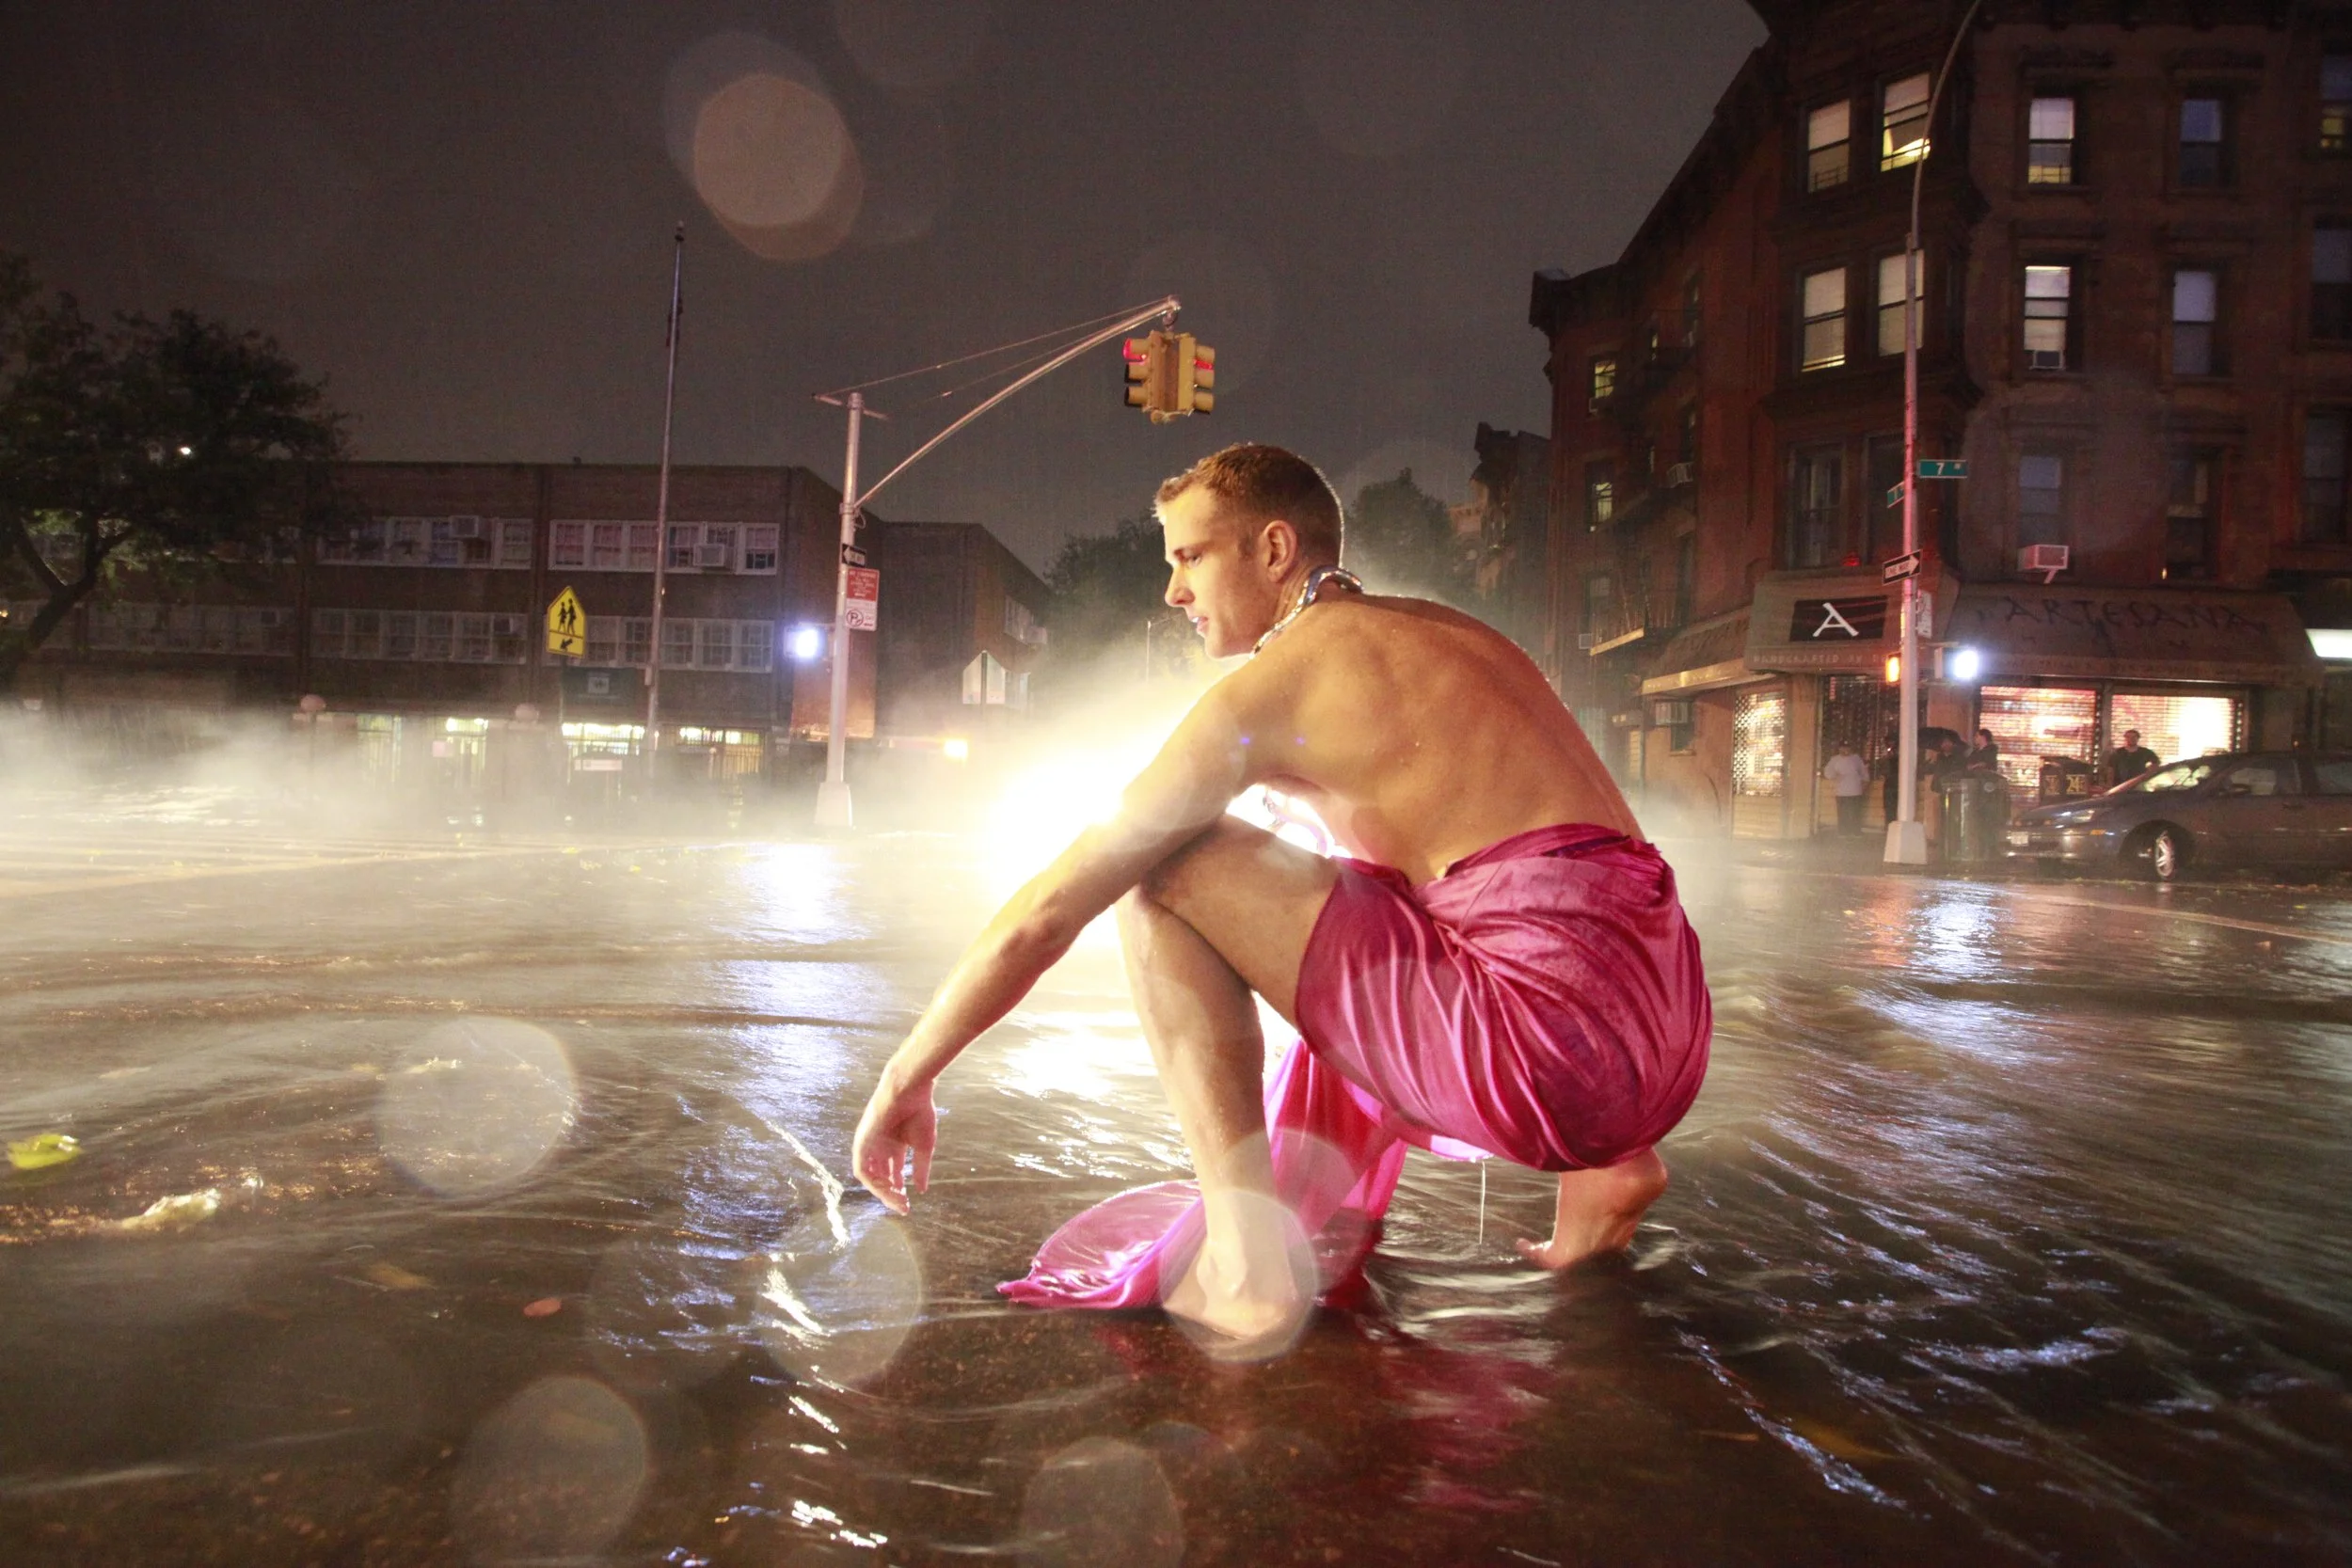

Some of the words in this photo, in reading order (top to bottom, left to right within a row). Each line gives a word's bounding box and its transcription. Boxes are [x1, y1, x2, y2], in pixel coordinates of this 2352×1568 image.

[1936, 462, 1945, 476] 7
[1812, 602, 1860, 638] A
[2004, 595, 2265, 634] ARTESANA
